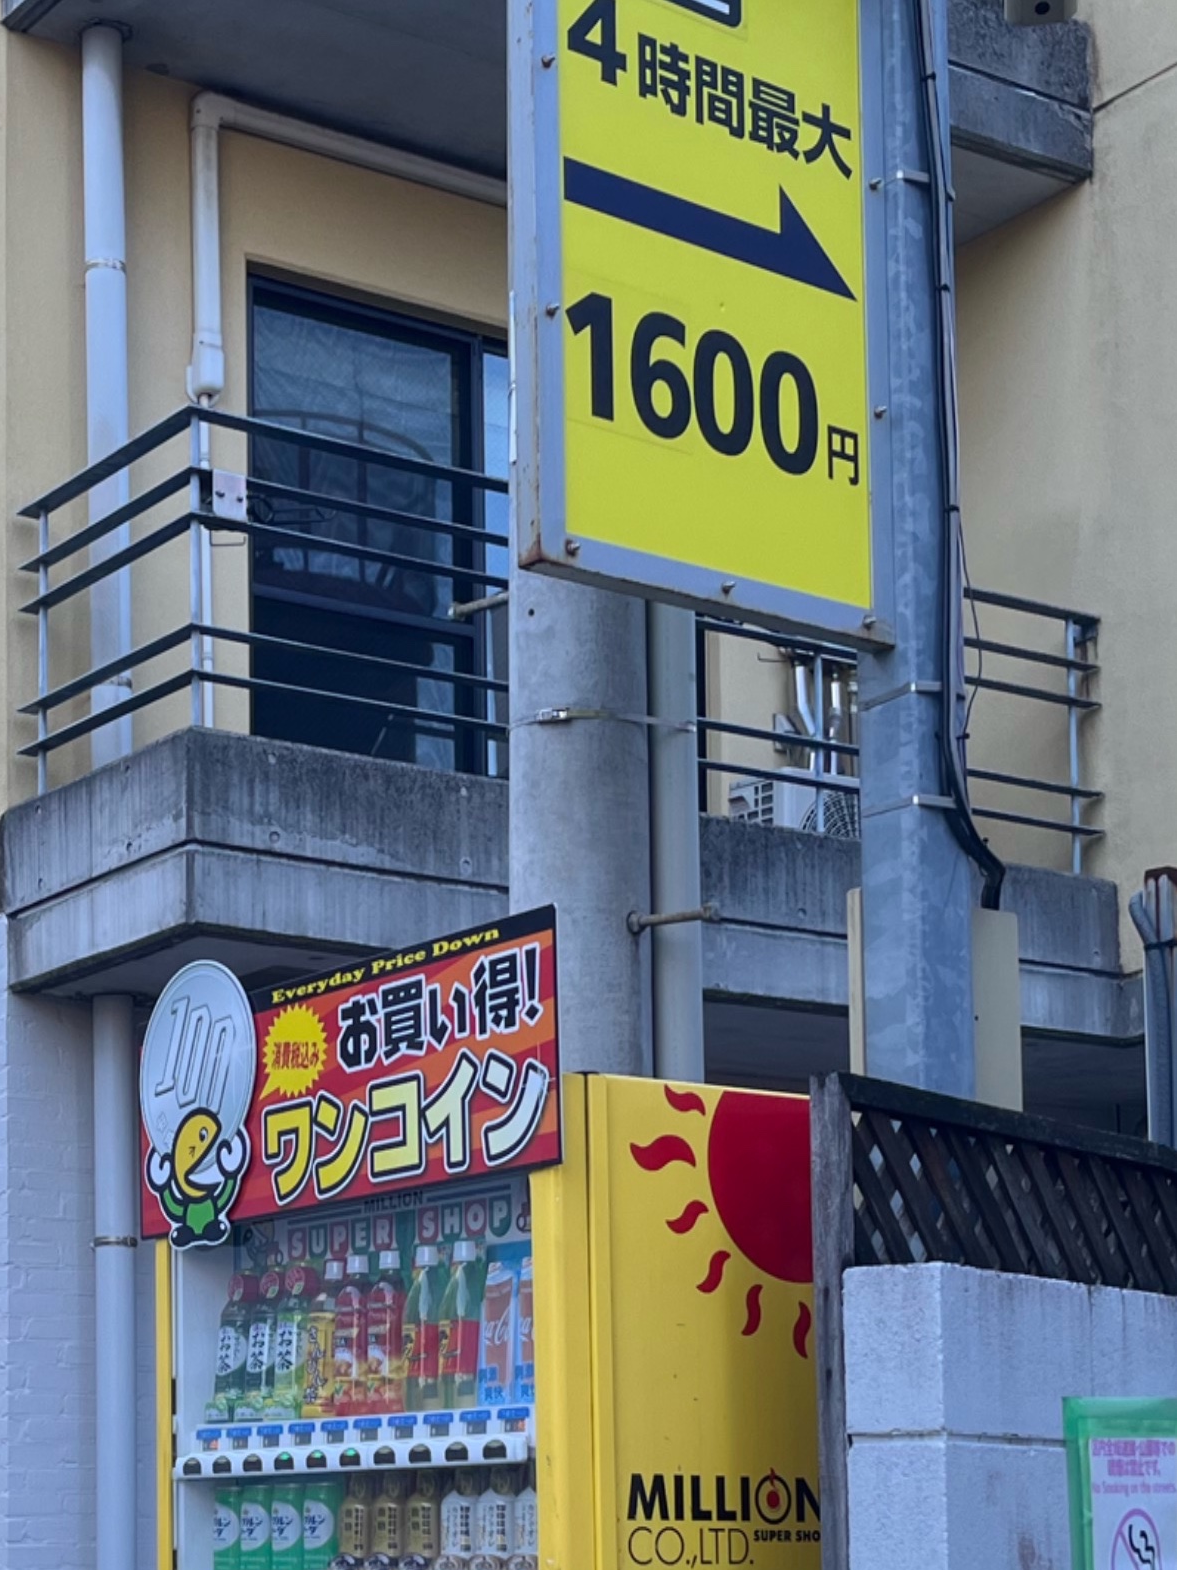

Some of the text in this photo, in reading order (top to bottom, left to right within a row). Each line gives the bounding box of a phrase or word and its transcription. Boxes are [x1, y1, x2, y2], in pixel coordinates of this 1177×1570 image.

[566, 0, 853, 180] 4時間最大
[565, 291, 859, 486] 1600円
[271, 926, 500, 1004] Everyday Price Down
[339, 945, 541, 1071] お買い得!
[263, 1050, 550, 1204] ワンコイン
[290, 1200, 510, 1258] SUPER SHOP
[363, 1191, 424, 1213] MILLION
[627, 1471, 821, 1525] MILLION
[753, 1530, 792, 1543] SUPER
[795, 1530, 822, 1543] SHO
